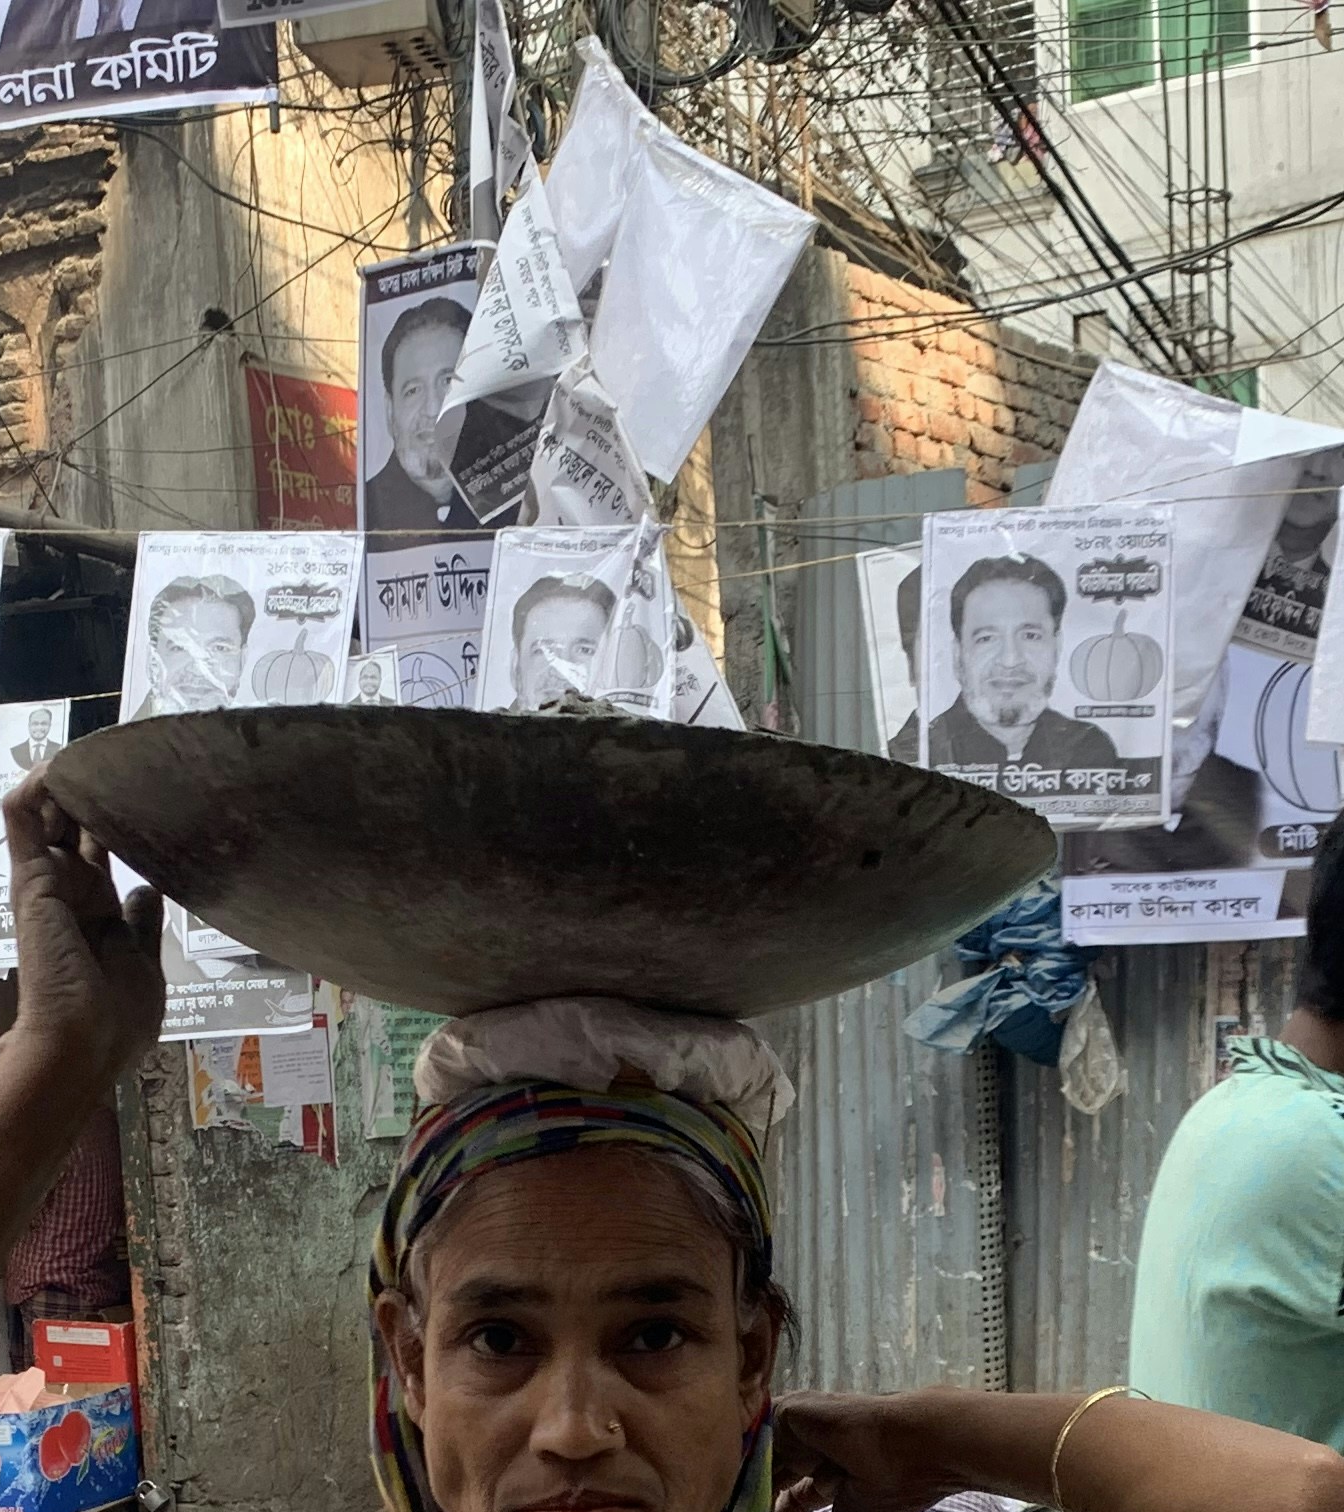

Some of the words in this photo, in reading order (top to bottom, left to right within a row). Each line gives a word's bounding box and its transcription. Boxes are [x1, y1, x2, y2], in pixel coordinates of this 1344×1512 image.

[87, 31, 219, 92] কমিটি
[1116, 530, 1168, 550] ওয়ার্ডের
[376, 572, 432, 622] কামাল
[433, 553, 490, 616] উদ্দিন
[1002, 765, 1062, 793] উদ্দিন
[1110, 880, 1152, 894] সাবেক
[1067, 899, 1133, 920] কামাল
[1139, 895, 1198, 919] উদ্দিন
[1203, 896, 1262, 919] কাবুল
